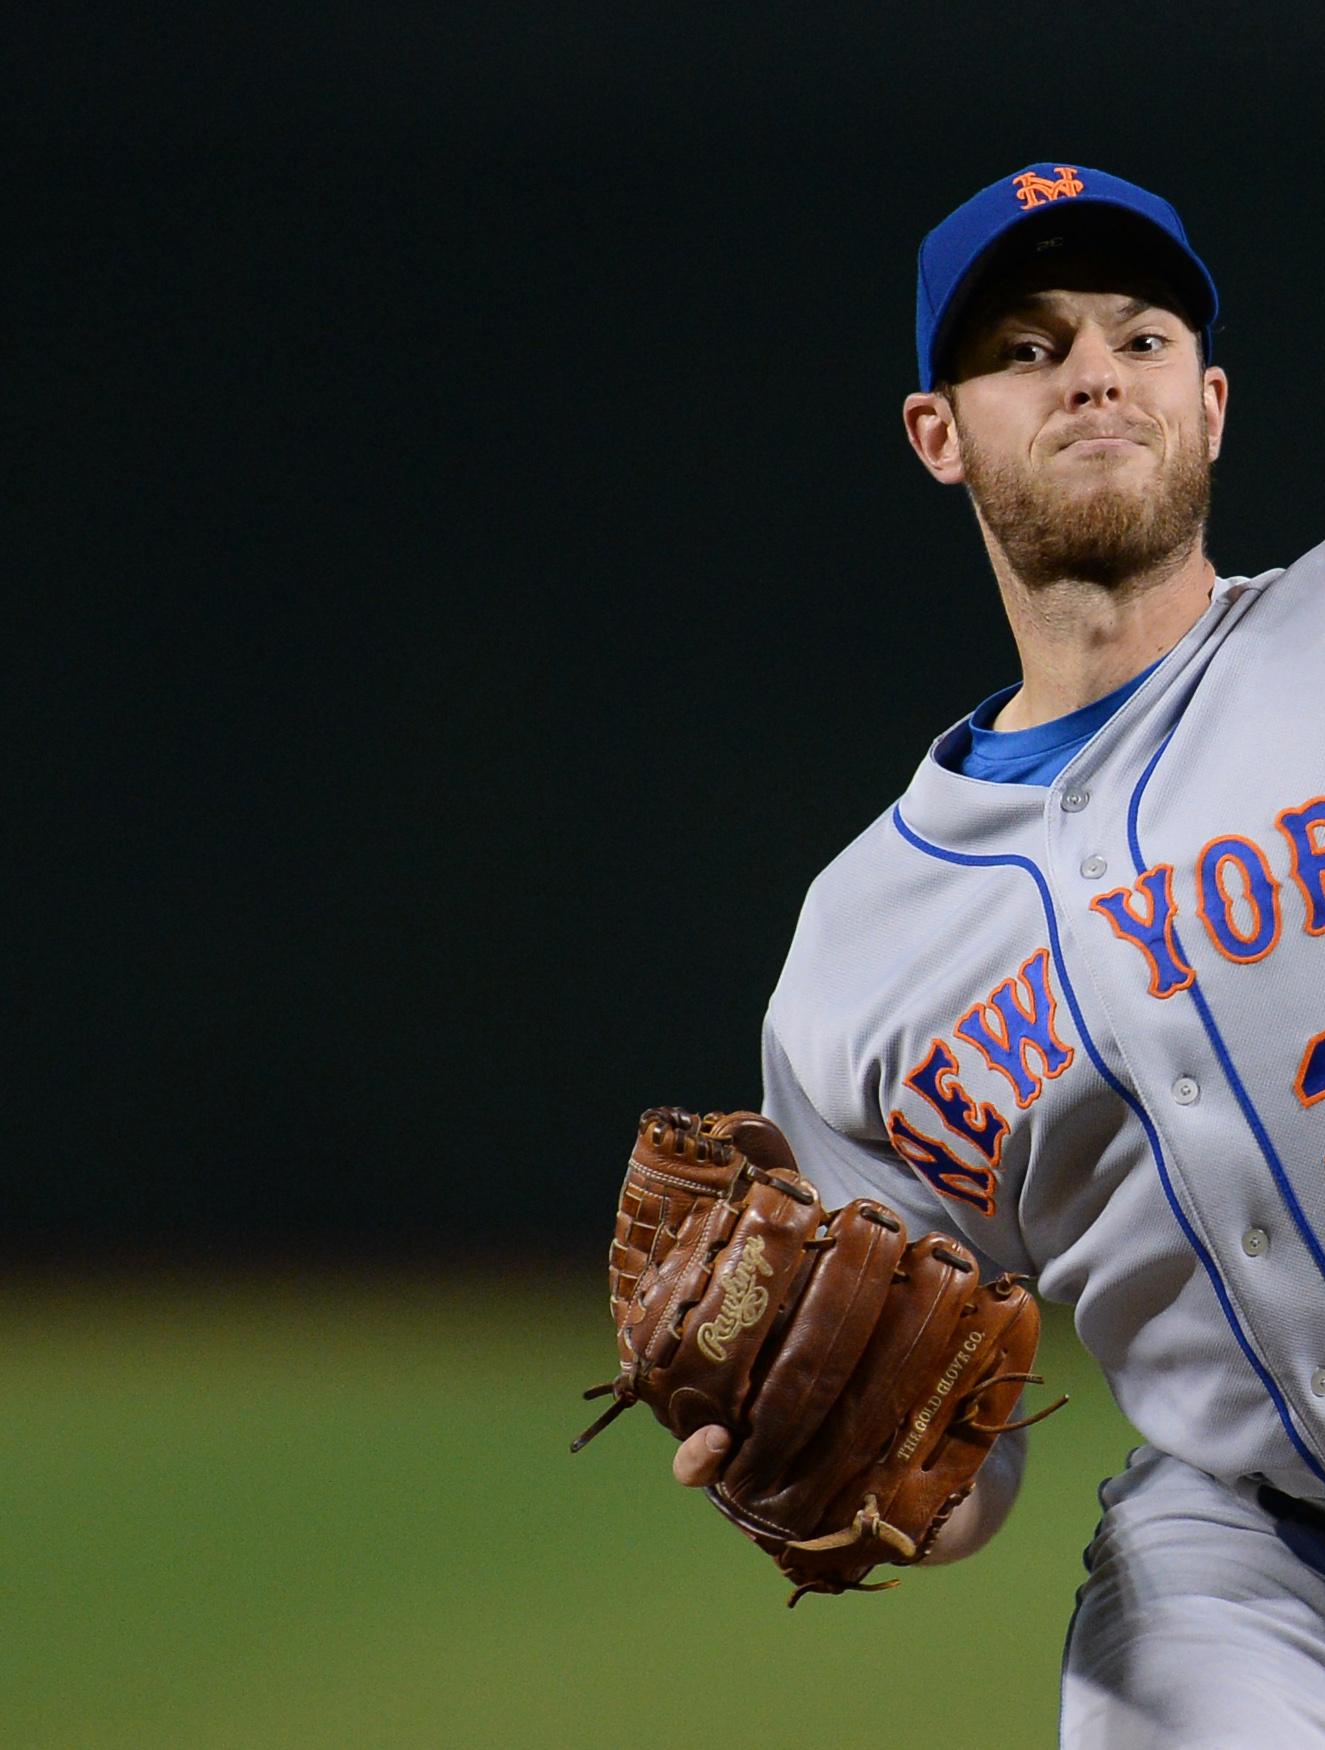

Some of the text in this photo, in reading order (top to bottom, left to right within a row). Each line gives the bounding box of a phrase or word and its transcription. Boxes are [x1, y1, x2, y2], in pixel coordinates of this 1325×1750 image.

[888, 948, 1075, 1217] NEW
[697, 1235, 774, 1361] Rawlings
[897, 1331, 986, 1461] THE GOLD GLOVE CO.
